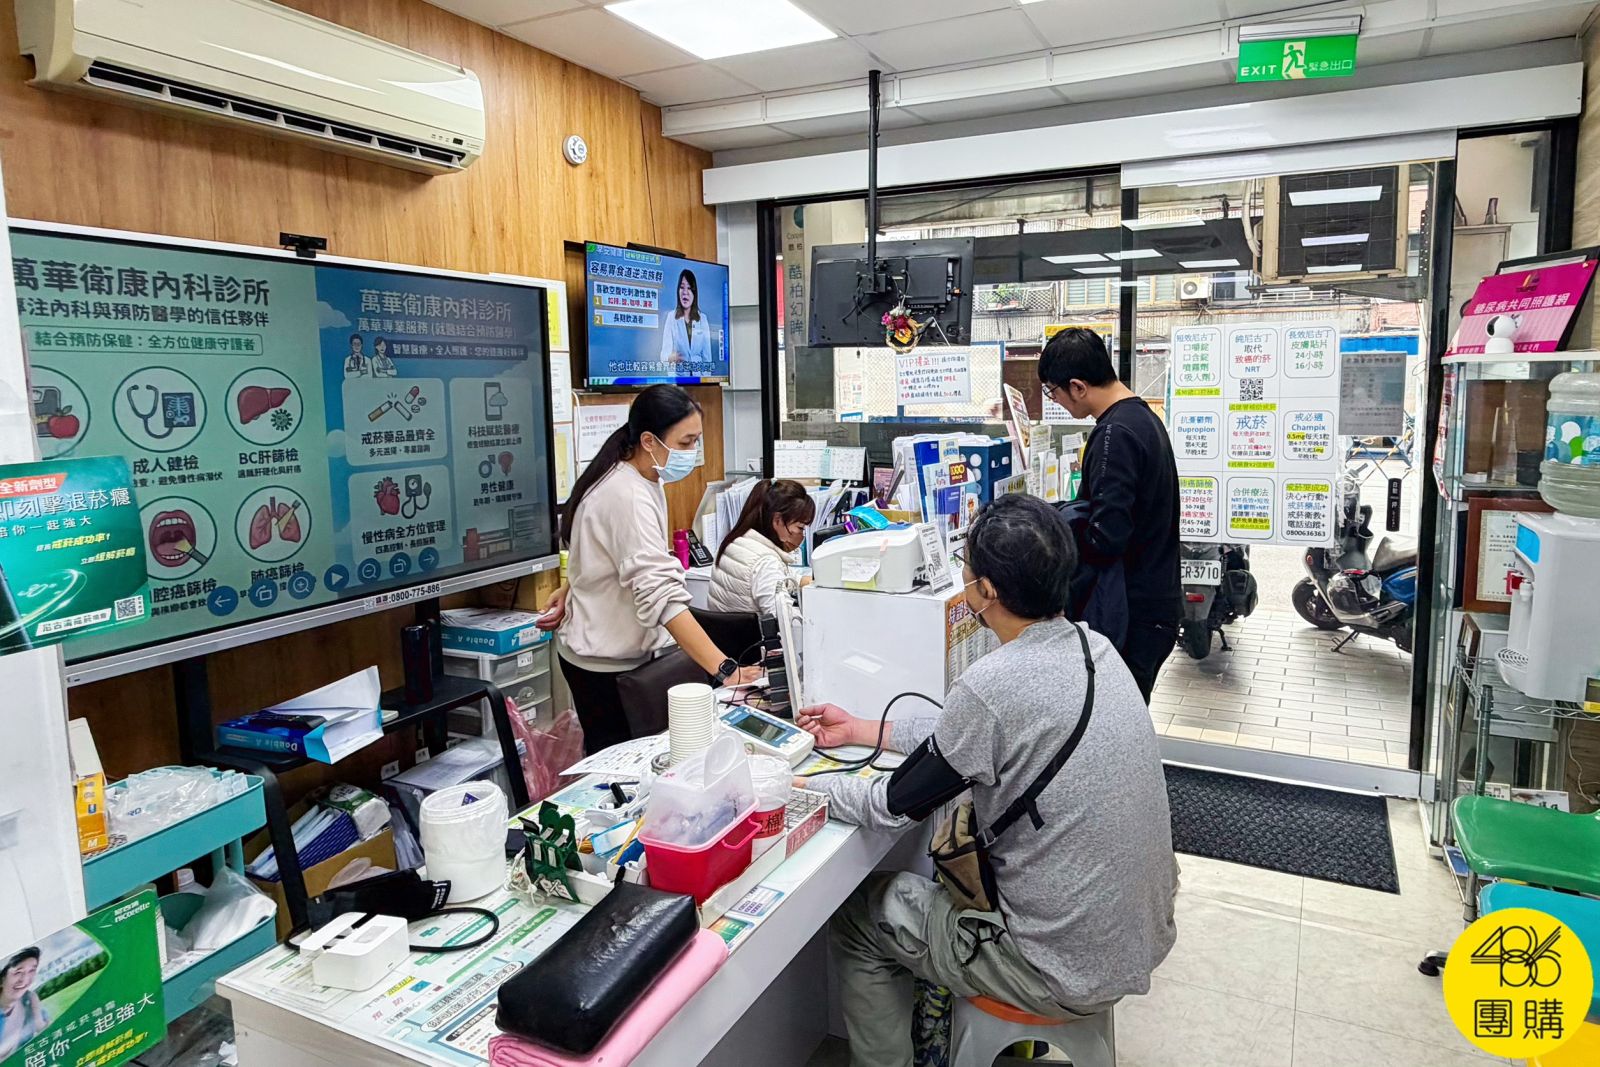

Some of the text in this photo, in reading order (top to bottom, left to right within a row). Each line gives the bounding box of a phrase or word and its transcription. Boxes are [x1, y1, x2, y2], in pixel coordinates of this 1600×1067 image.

[1240, 64, 1277, 77] EXIT
[1308, 59, 1353, 72] 緊急出口
[590, 261, 663, 282] 容易胃食道逆流族群
[11, 257, 270, 306] 萬華衛康內科診所
[359, 288, 513, 323] 萬華衛康內科診所
[1473, 293, 1571, 314] 糖尿病共同照護網
[1288, 329, 1332, 340] 長效尼古丁
[1244, 344, 1263, 353] 取代
[1295, 350, 1324, 360] 24小時
[1234, 354, 1272, 364] 致癌的菸
[1295, 361, 1324, 371] 16小時
[1244, 365, 1261, 373] NRT
[1177, 426, 1216, 434] Bupropion
[1236, 414, 1268, 430] 戒菸
[1291, 423, 1326, 432] Champix
[361, 428, 436, 446] 戒菸藥品最齊全
[238, 447, 300, 465] BC肝篩檢
[132, 454, 200, 475] 成人健檢
[480, 479, 515, 495] 男性健康
[361, 519, 447, 545] 慢性病全方位管理
[149, 578, 218, 605] 腔癌篩檢
[465, 633, 495, 647] Double
[24, 992, 155, 1067] 陪你一起強大
